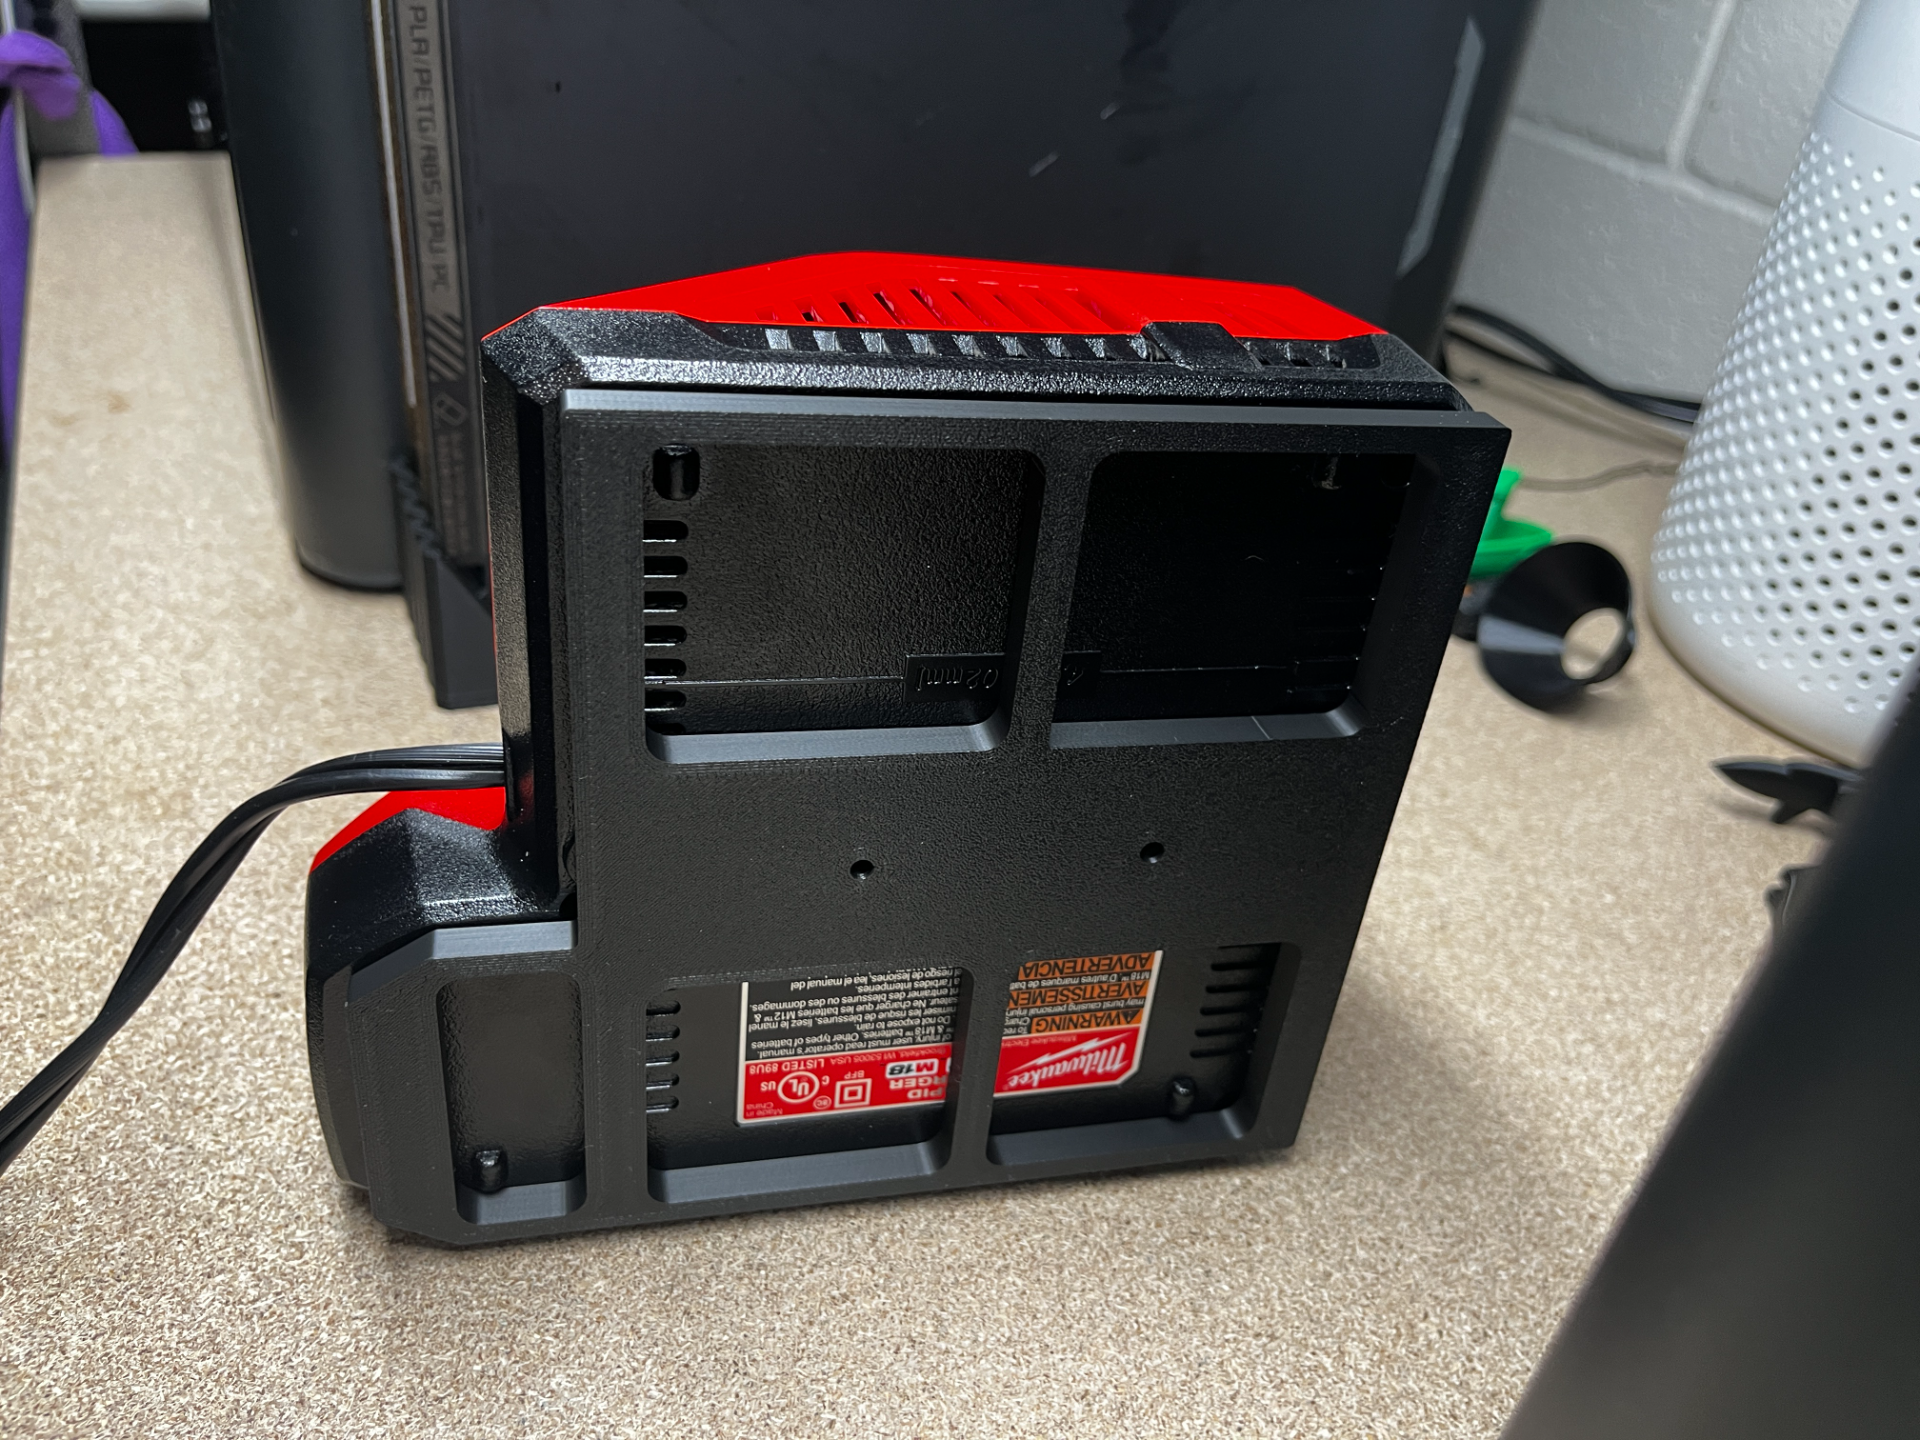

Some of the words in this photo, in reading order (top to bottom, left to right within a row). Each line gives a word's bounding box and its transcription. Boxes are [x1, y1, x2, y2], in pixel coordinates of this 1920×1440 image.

[1022, 952, 1151, 979] ADVERTENCIA
[853, 975, 867, 985] lea
[911, 971, 923, 980] de
[790, 981, 805, 991] del
[806, 977, 842, 989] manual
[843, 976, 852, 986] el
[1027, 979, 1039, 988] de
[1040, 975, 1079, 987] marques
[841, 992, 886, 1005] blessures
[888, 991, 905, 1001] des
[1008, 981, 1145, 1006] AVERTISSEMEN
[749, 997, 806, 1013] dommages.
[807, 998, 825, 1008] des
[827, 997, 839, 1005] ou
[875, 998, 911, 1011] charger
[912, 999, 926, 1008] Ne
[928, 995, 957, 1006] sateur.
[1102, 1000, 1124, 1009] burst
[1125, 997, 1144, 1007] may
[840, 1005, 854, 1014] les
[855, 1001, 874, 1011] que
[922, 1005, 956, 1016] nimiser
[1028, 1004, 1066, 1015] personal
[797, 1006, 838, 1018] batteries
[864, 1012, 876, 1021] de
[878, 1008, 906, 1020] risque
[908, 1008, 921, 1017] les
[753, 1013, 761, 1022] &
[886, 1016, 920, 1027] expose
[921, 1016, 936, 1025] not
[937, 1015, 950, 1024] Do
[1034, 1011, 1120, 1032] WARNING
[748, 1021, 778, 1032] manel
[780, 1020, 788, 1029] le
[790, 1018, 812, 1028] lisez
[854, 1022, 874, 1031] rain.
[875, 1021, 885, 1029] to
[937, 1024, 944, 1033] &
[805, 1032, 830, 1045] types
[832, 1032, 858, 1042] Other
[861, 1028, 903, 1040] batteries.
[751, 1038, 792, 1049] batteries
[793, 1037, 803, 1046] of
[845, 1040, 866, 1049] read
[867, 1038, 890, 1047] must
[892, 1036, 912, 1044] user
[757, 1047, 794, 1058] manual.
[796, 1041, 843, 1054] operator's
[781, 1058, 824, 1071] LISTED
[829, 1055, 851, 1065] USA
[1006, 1042, 1129, 1088] Milwaukee
[749, 1062, 778, 1074] 89U8
[887, 1061, 934, 1076] M18
[843, 1069, 864, 1079] BFP
[760, 1080, 776, 1091] US
[888, 1074, 946, 1089] RGER
[906, 1086, 943, 1099] PID
[746, 1101, 773, 1110] China
[756, 1107, 782, 1116] Made
